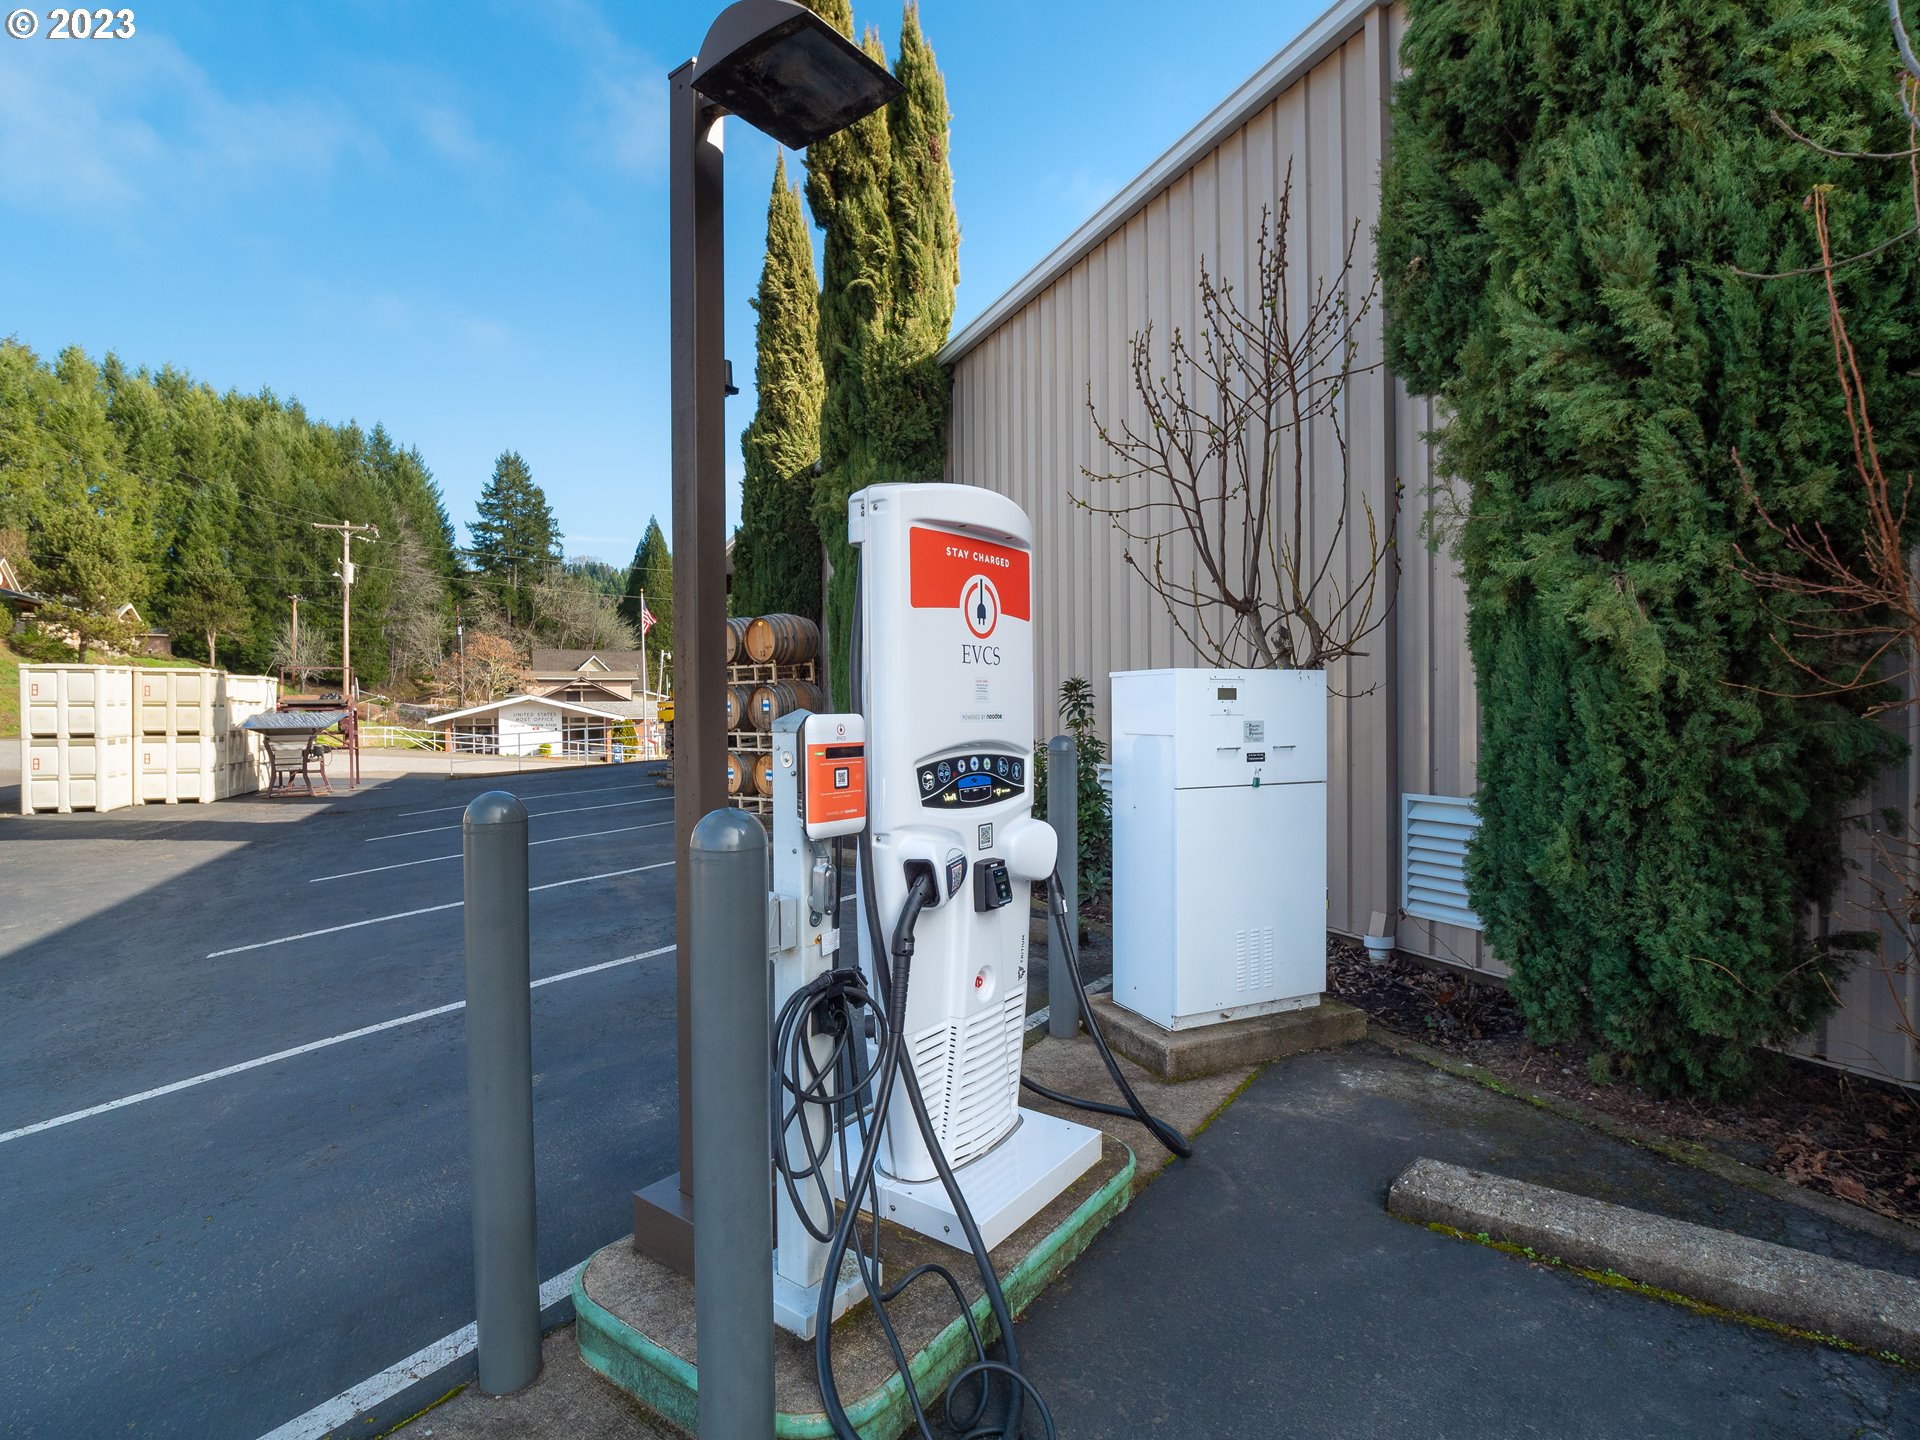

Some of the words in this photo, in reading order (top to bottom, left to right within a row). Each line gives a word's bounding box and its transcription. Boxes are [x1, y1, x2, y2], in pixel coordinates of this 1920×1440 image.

[946, 546, 969, 560] STAY
[973, 552, 1009, 568] CHARGED
[962, 644, 1001, 666] EVCS
